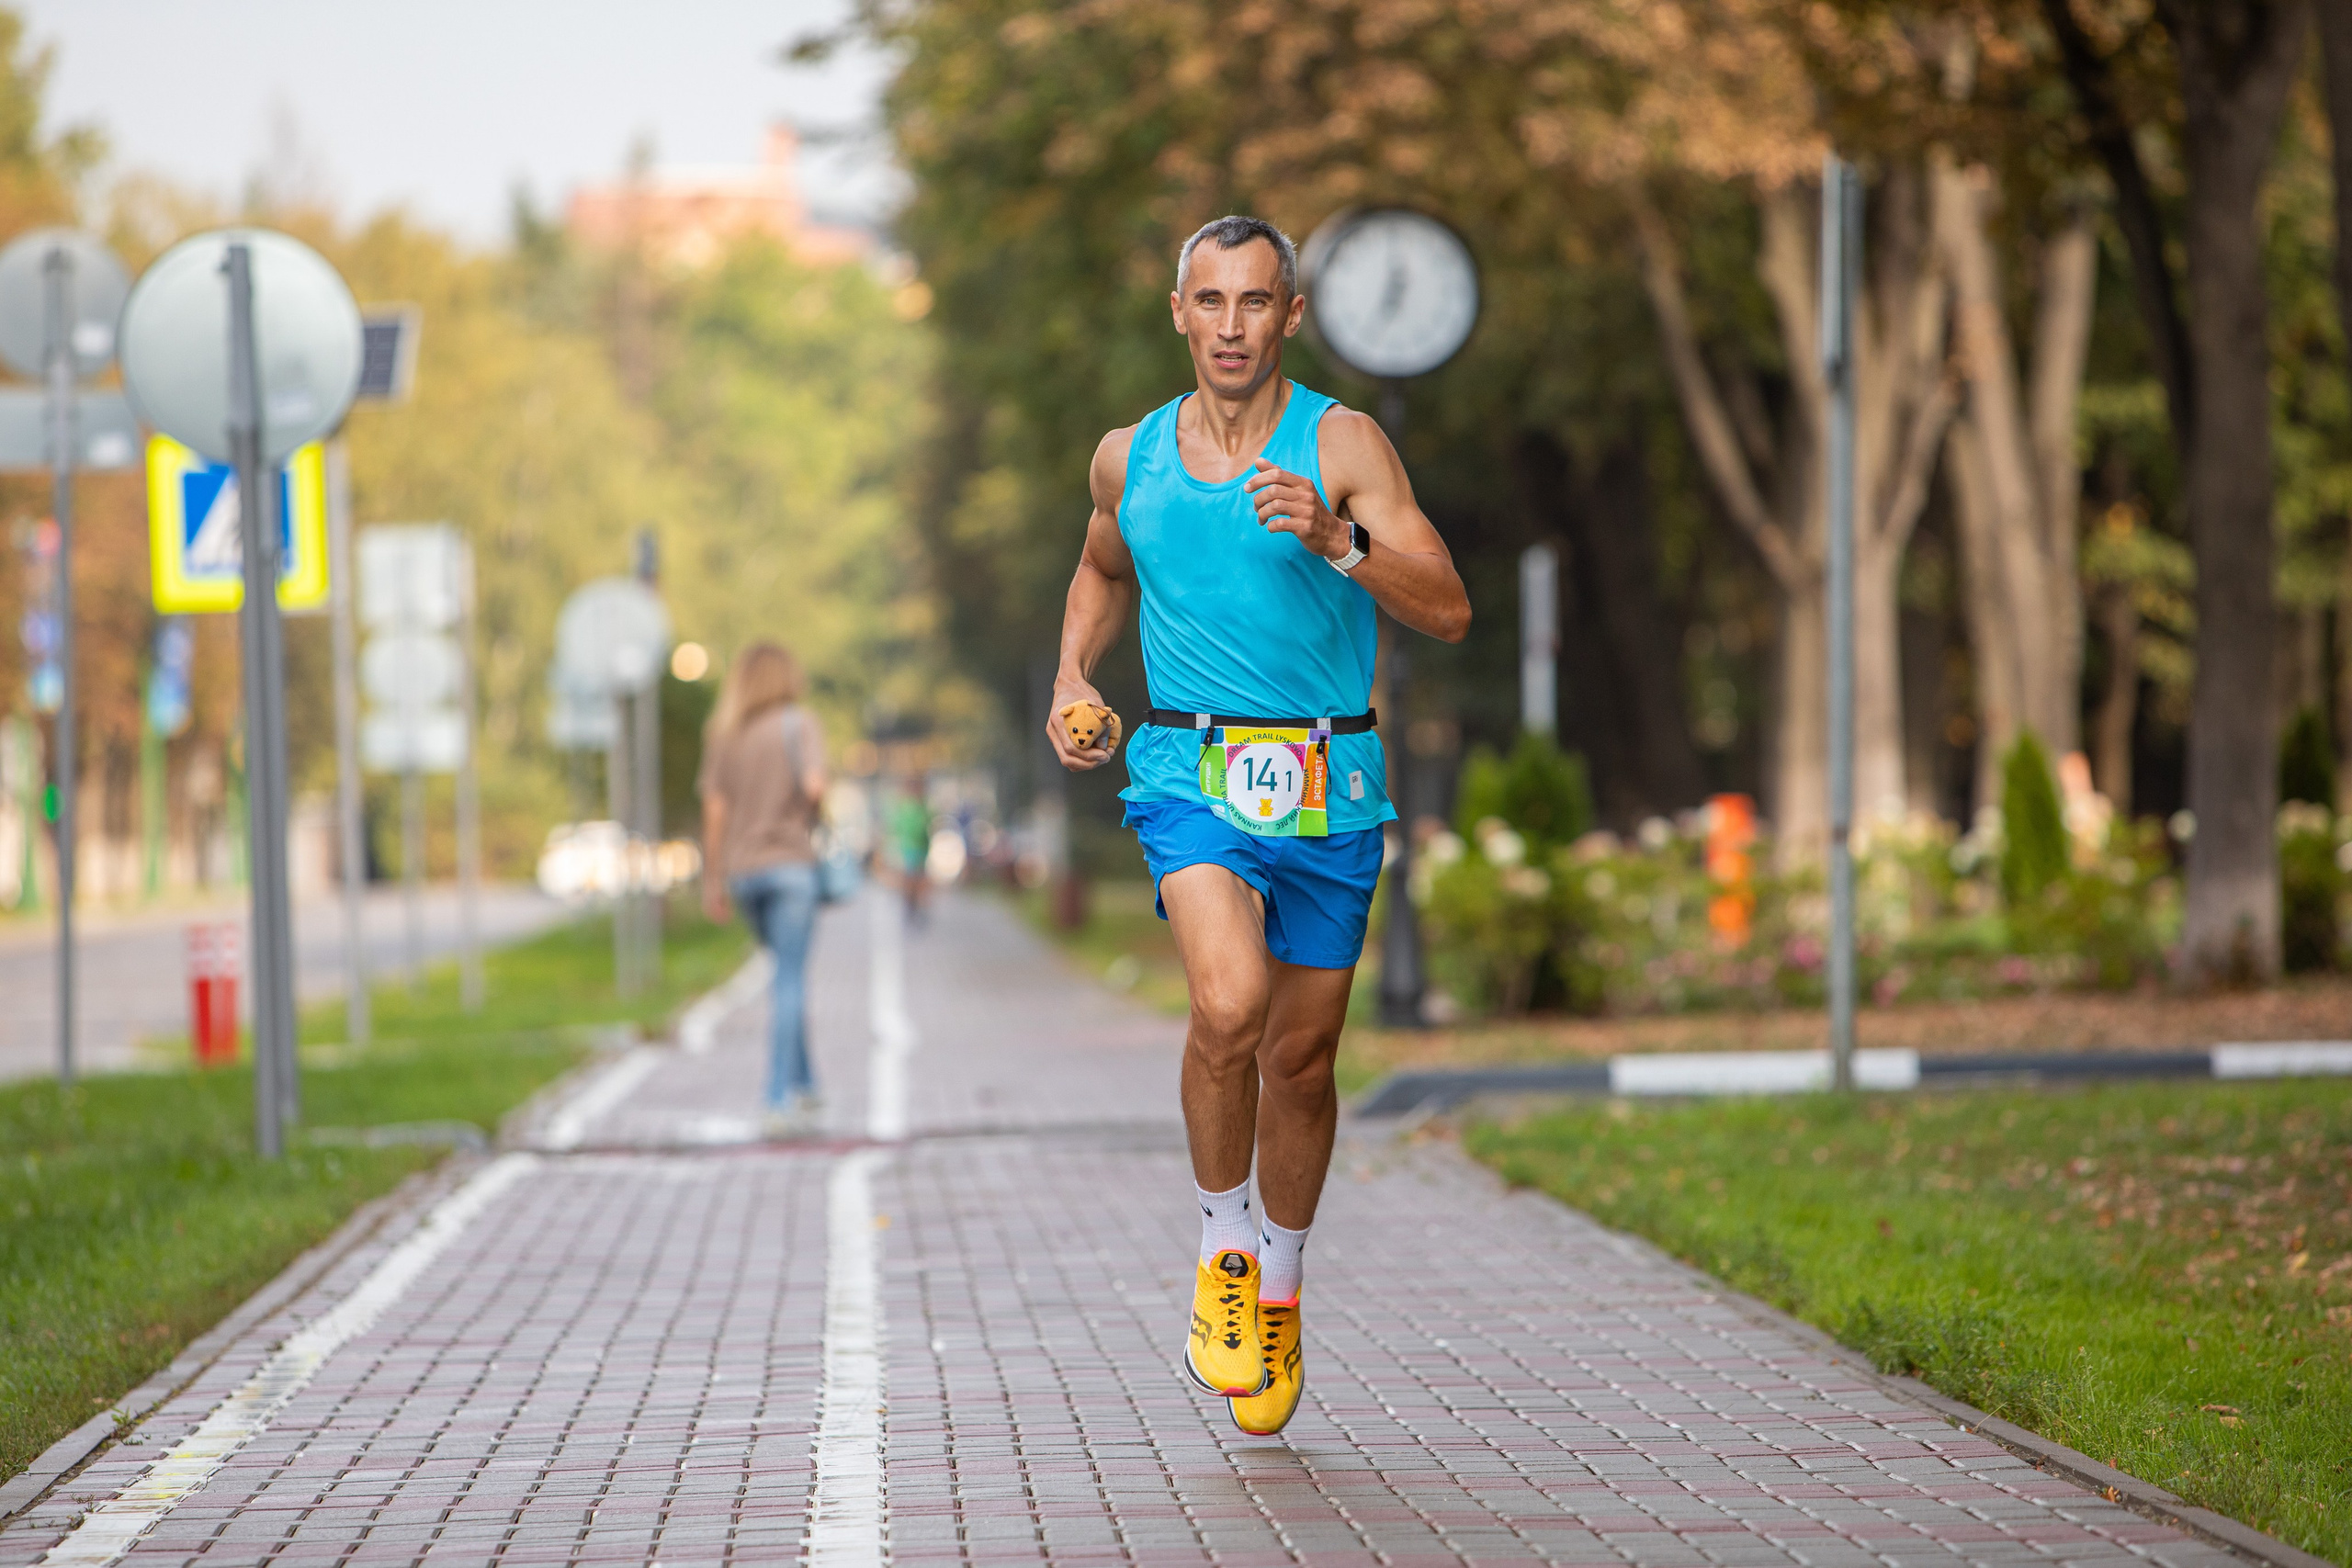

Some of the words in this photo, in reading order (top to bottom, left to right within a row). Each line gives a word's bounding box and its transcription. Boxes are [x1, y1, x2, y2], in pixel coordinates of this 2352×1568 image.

[1227, 737, 1251, 758] DREAM
[1275, 735, 1303, 757] LYSKOVO
[1219, 768, 1227, 789] TRAIL
[1243, 758, 1277, 792] 14
[1285, 771, 1292, 792] 1
[1314, 753, 1324, 801] ЭСТАФЕТА
[1288, 768, 1310, 822] ХИМКИНСКИЙ
[1234, 812, 1262, 830] KANNAS
[1275, 820, 1289, 830] ЛЕС
